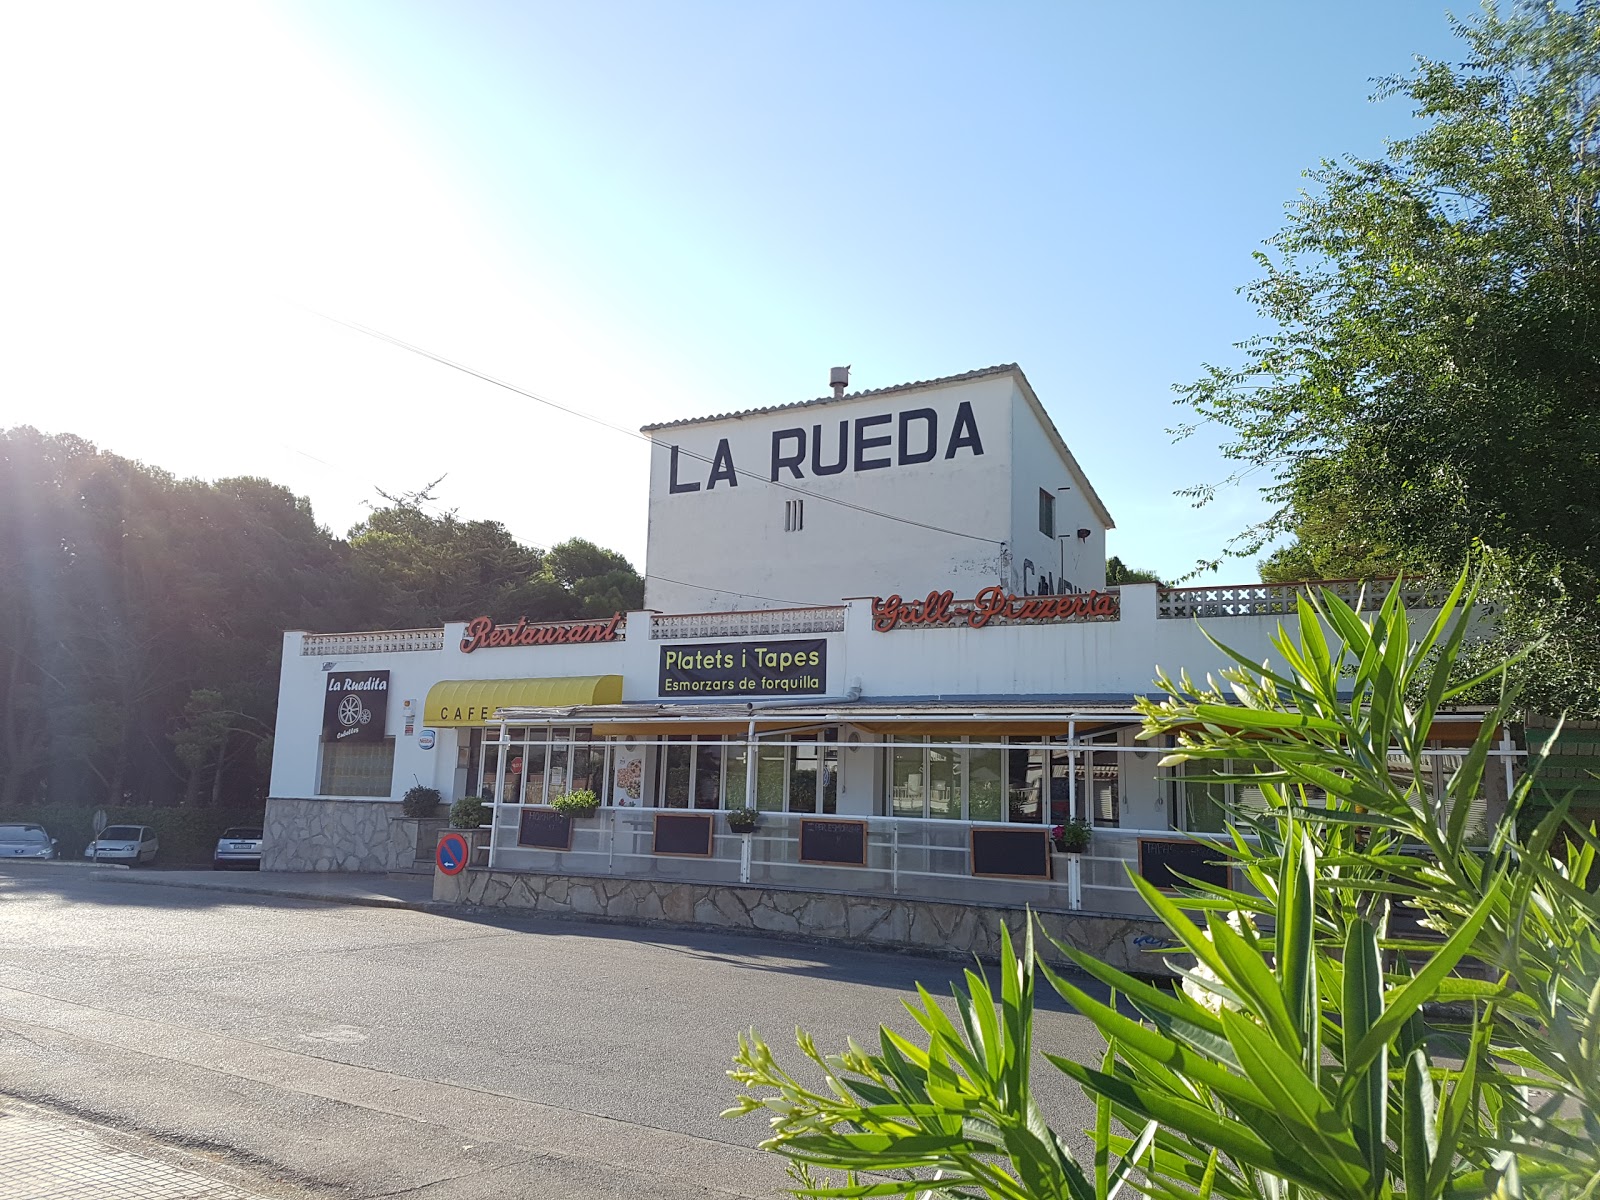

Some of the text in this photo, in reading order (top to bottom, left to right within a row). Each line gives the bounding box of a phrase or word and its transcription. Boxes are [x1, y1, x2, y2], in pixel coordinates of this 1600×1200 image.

[669, 401, 984, 494] LA RUEDA
[460, 611, 621, 653] Restaurant
[666, 648, 819, 672] Platets i Tapes
[328, 676, 387, 691] La Ruedita
[665, 675, 819, 692] Esmorzars de forquilla
[440, 706, 503, 720] CAFE
